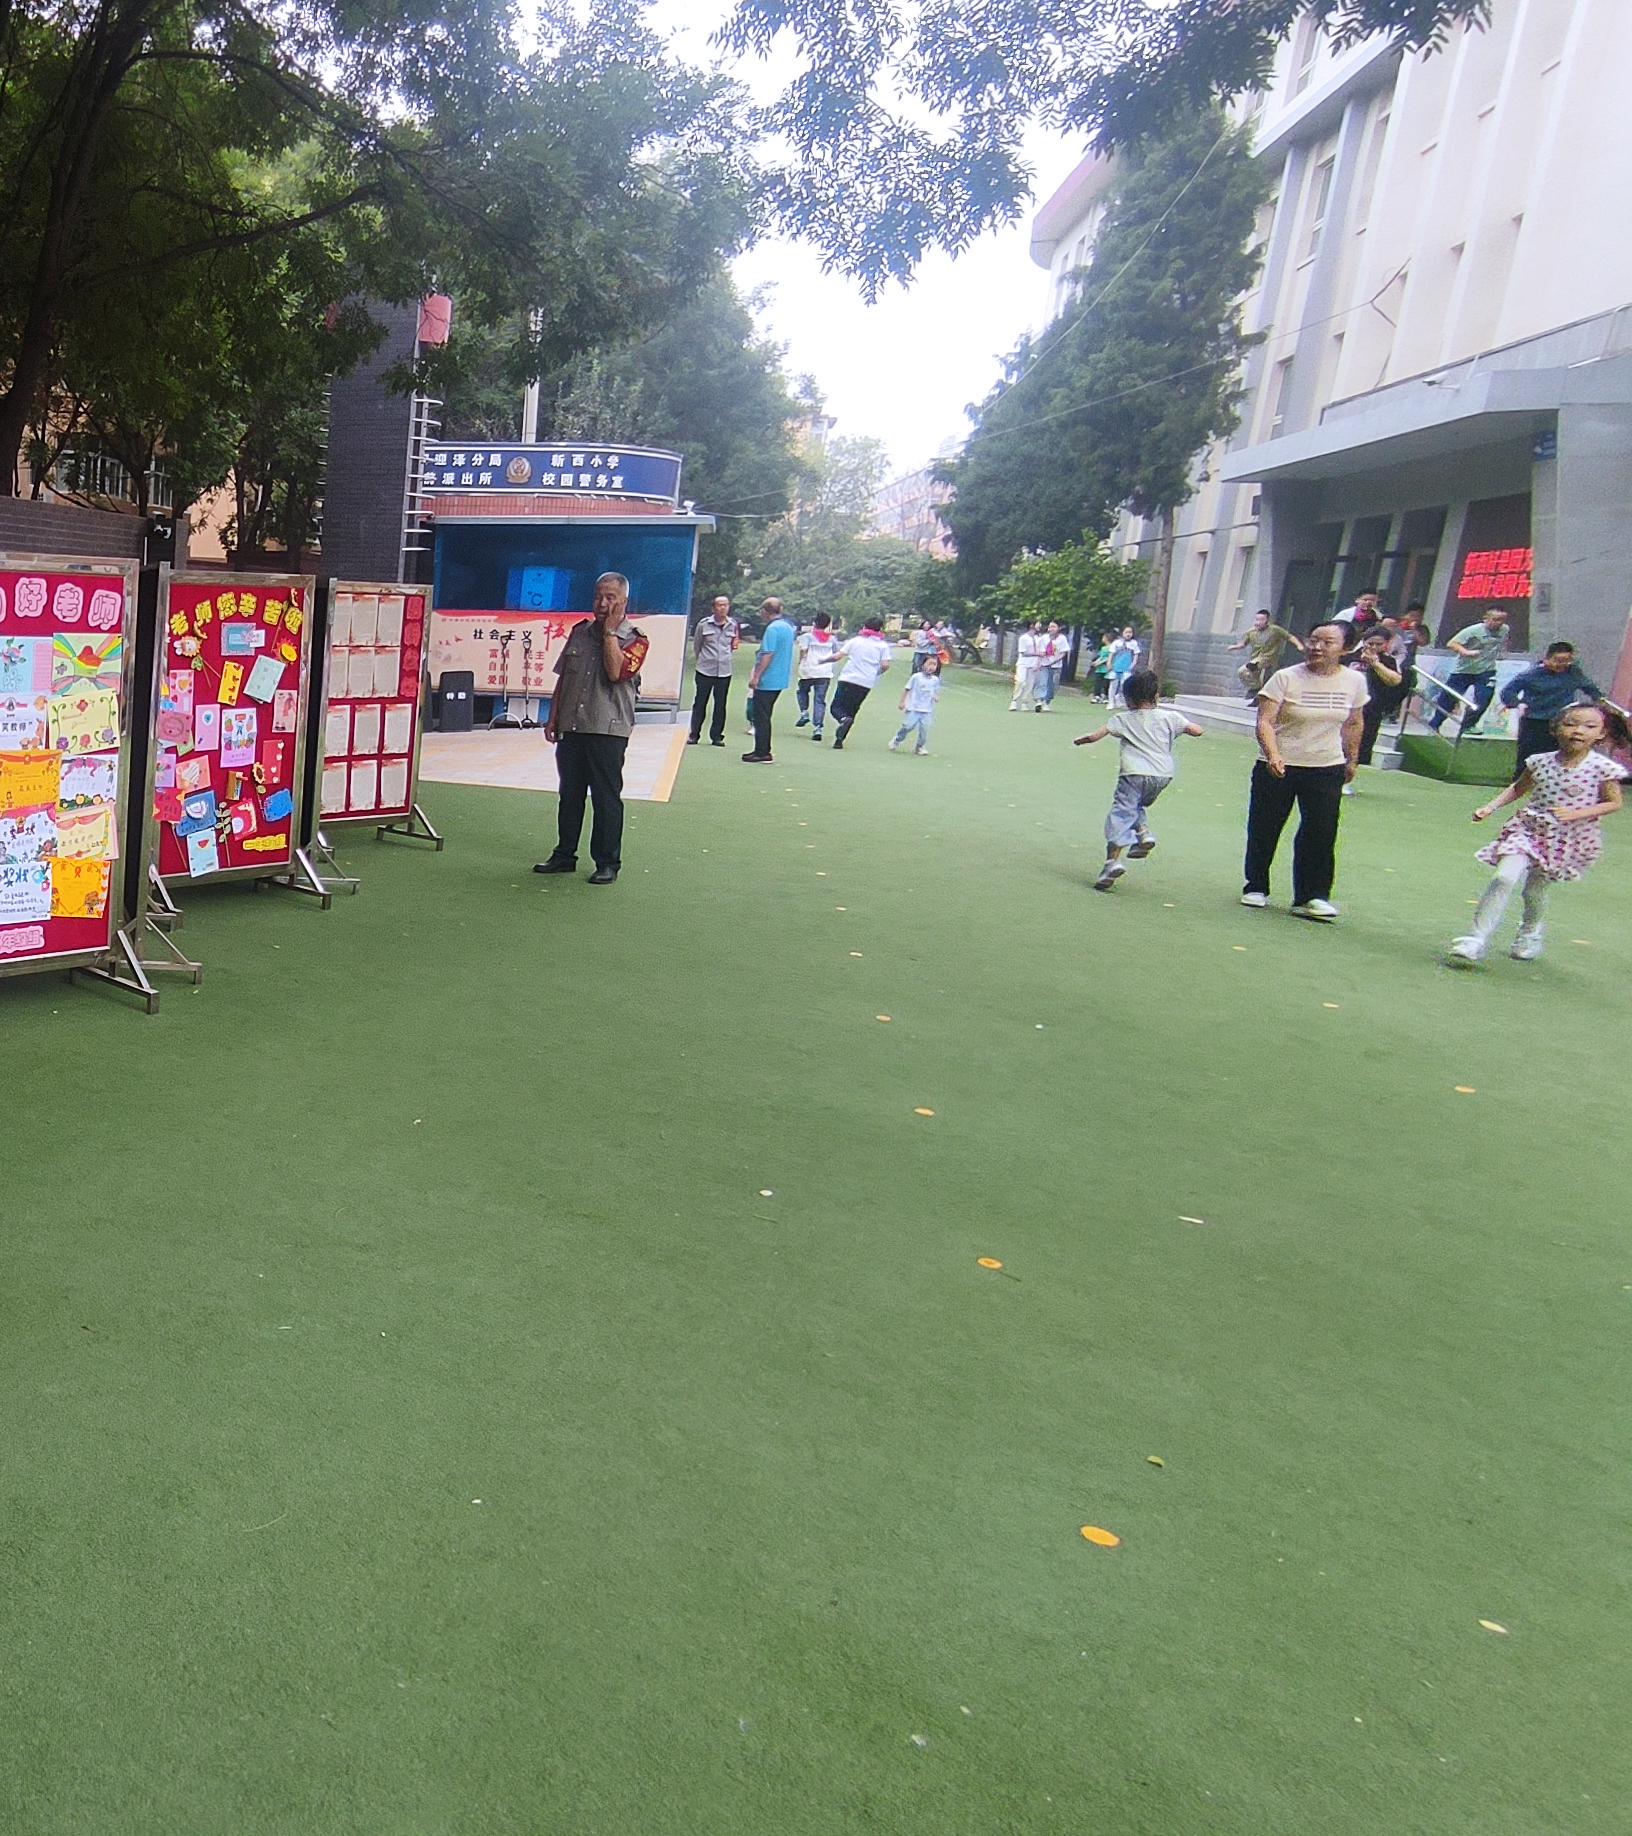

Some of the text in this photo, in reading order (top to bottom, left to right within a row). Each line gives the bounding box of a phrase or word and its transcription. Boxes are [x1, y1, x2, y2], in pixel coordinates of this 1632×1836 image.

[550, 453, 621, 470] 新西小学
[542, 472, 624, 489] 校园警务室
[473, 628, 533, 642] 社会主义
